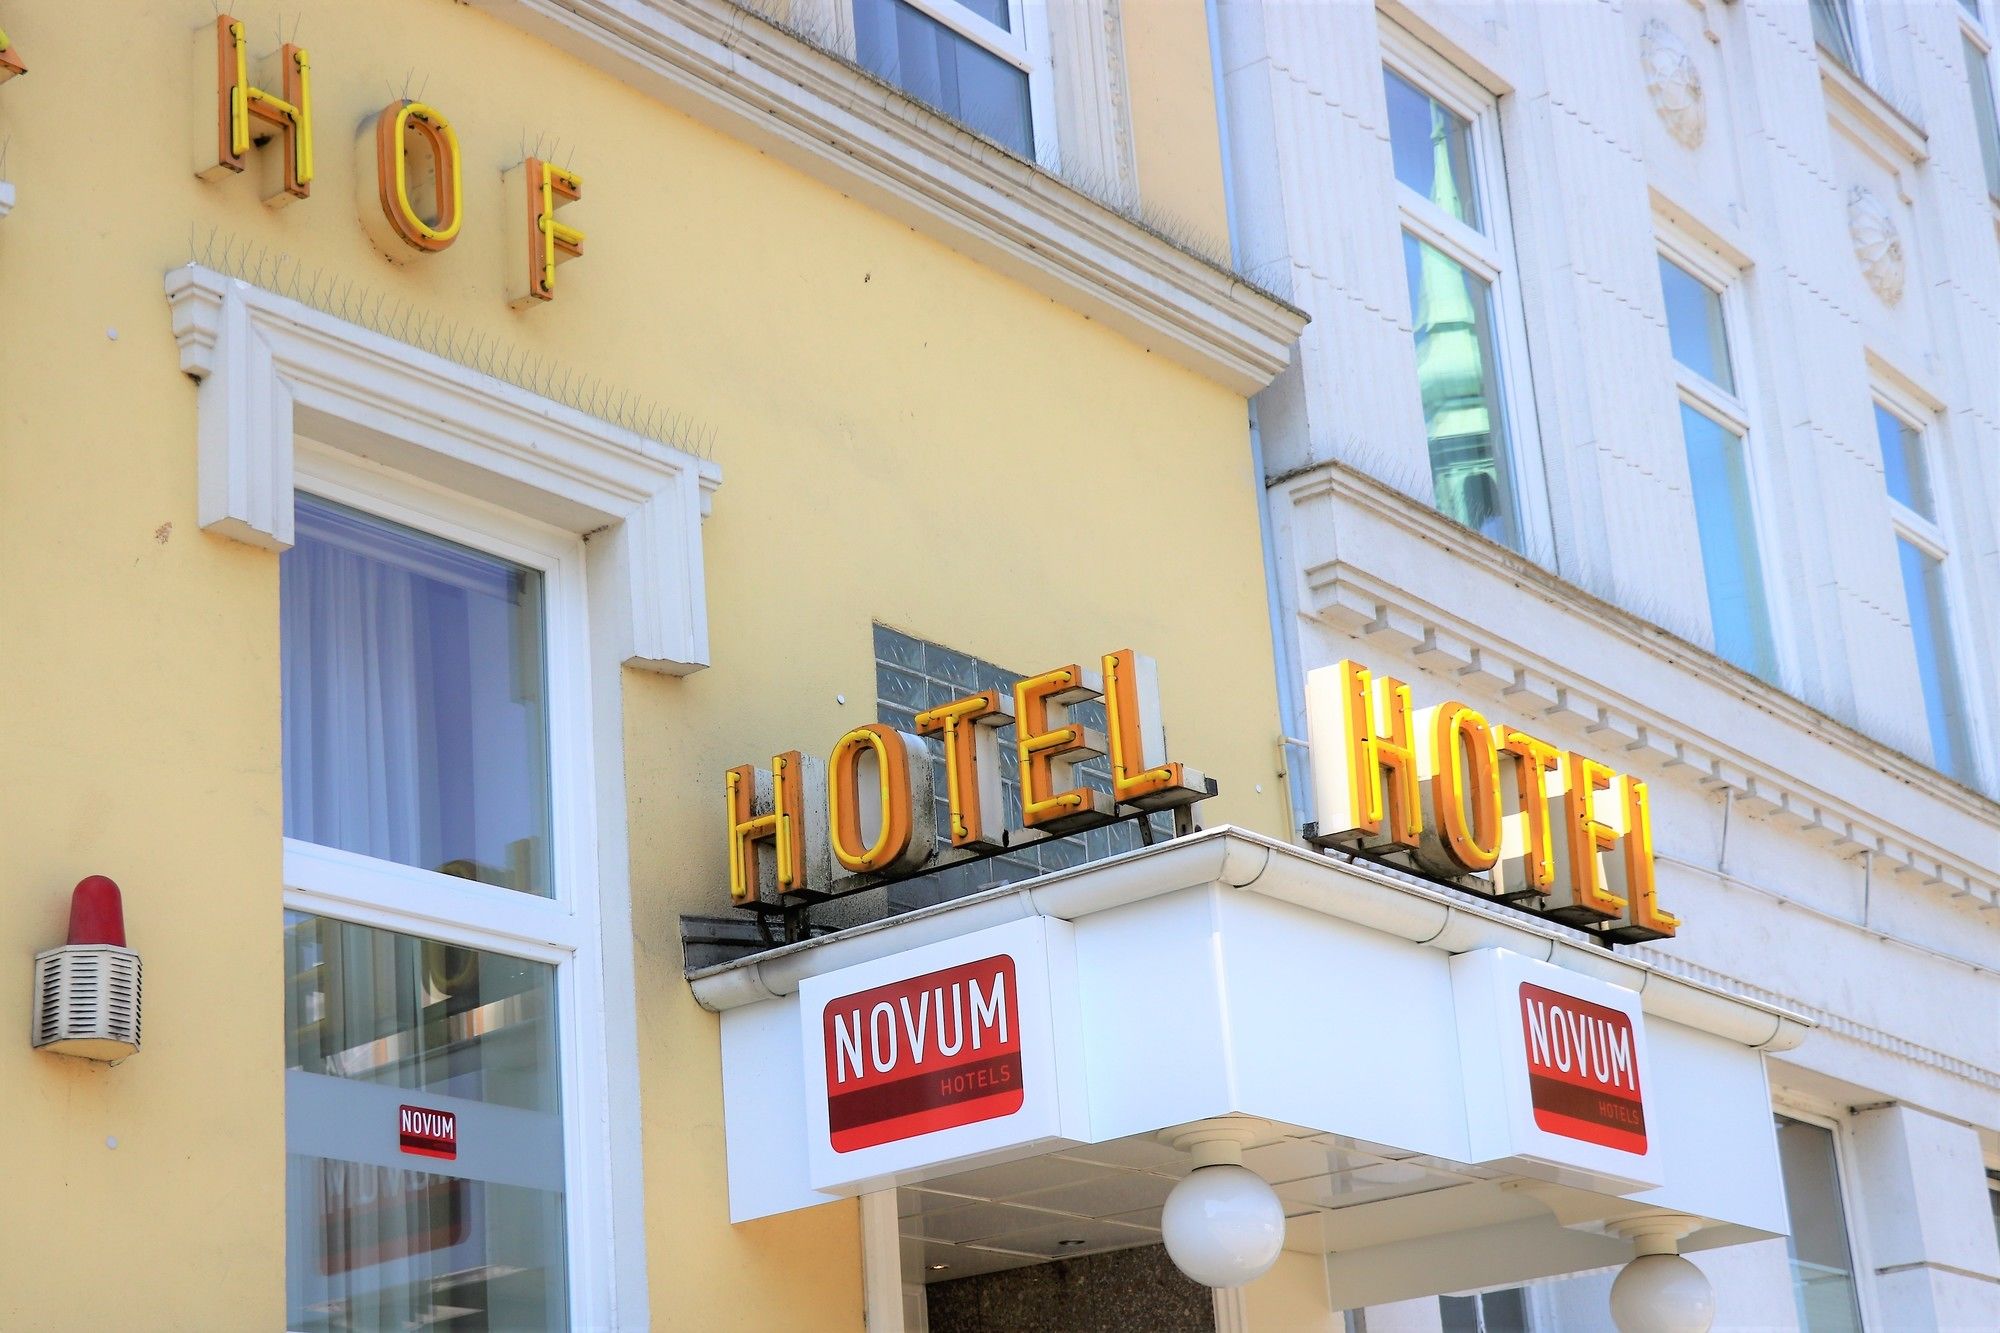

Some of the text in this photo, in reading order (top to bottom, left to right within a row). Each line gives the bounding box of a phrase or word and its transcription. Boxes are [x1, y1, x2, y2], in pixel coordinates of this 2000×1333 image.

[216, 13, 585, 302] HOF
[725, 648, 1188, 910] HOTEL
[1338, 658, 1682, 941] HOTEL
[834, 971, 1009, 1084] NOVUM
[1525, 997, 1635, 1091] NOVUM
[402, 1109, 454, 1140] NOVUM
[940, 1064, 1011, 1096] HOTELS
[1598, 1100, 1641, 1125] HOTELS
